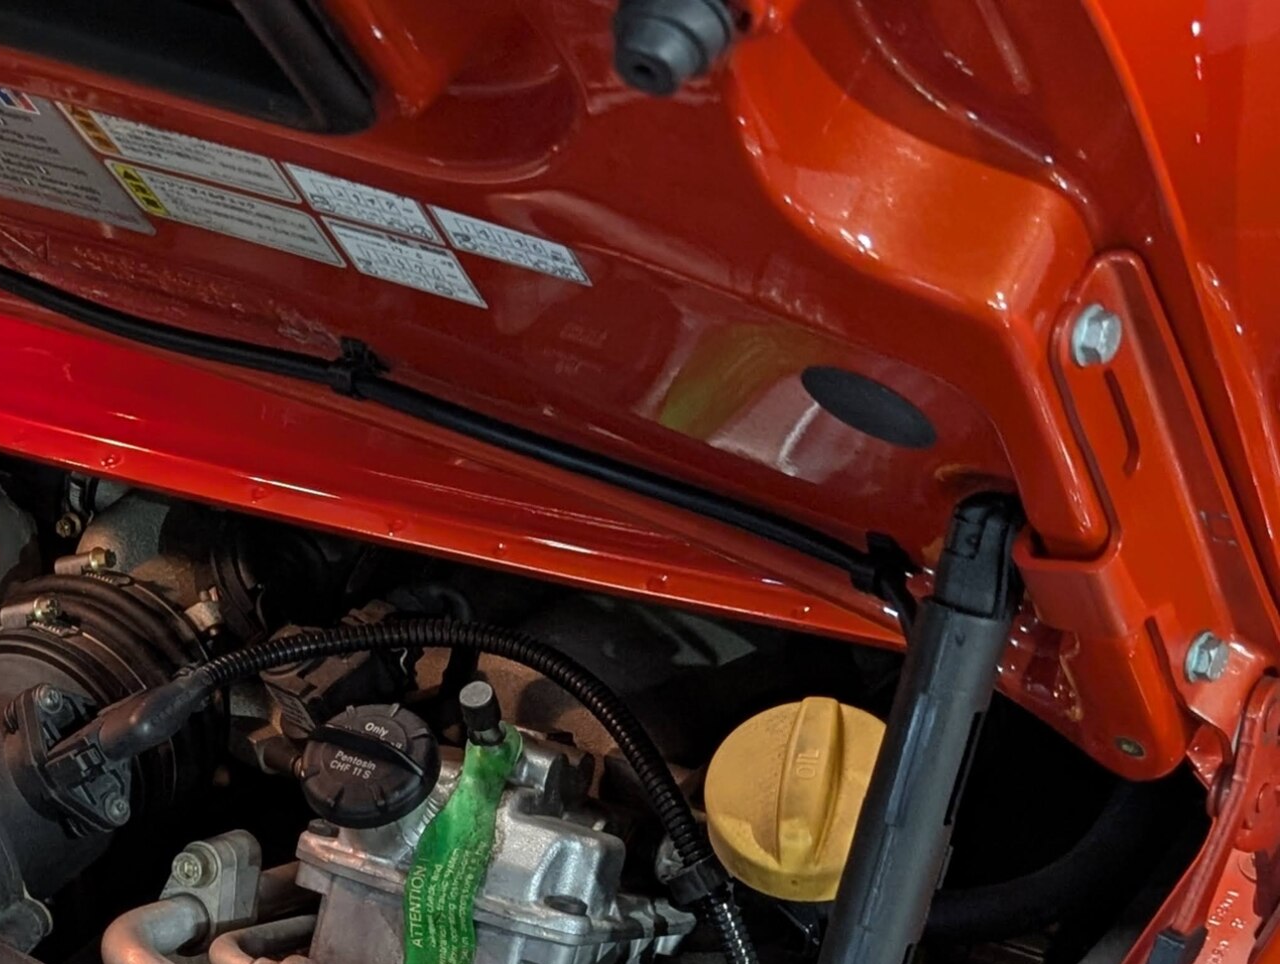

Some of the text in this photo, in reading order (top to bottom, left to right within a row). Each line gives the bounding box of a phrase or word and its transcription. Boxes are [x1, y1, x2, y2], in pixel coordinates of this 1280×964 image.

[365, 722, 389, 738] Only
[330, 760, 372, 780] CHF 11 S
[335, 750, 377, 771] Pentosin
[796, 749, 819, 779] OIL
[409, 865, 427, 948] ATTENTION
